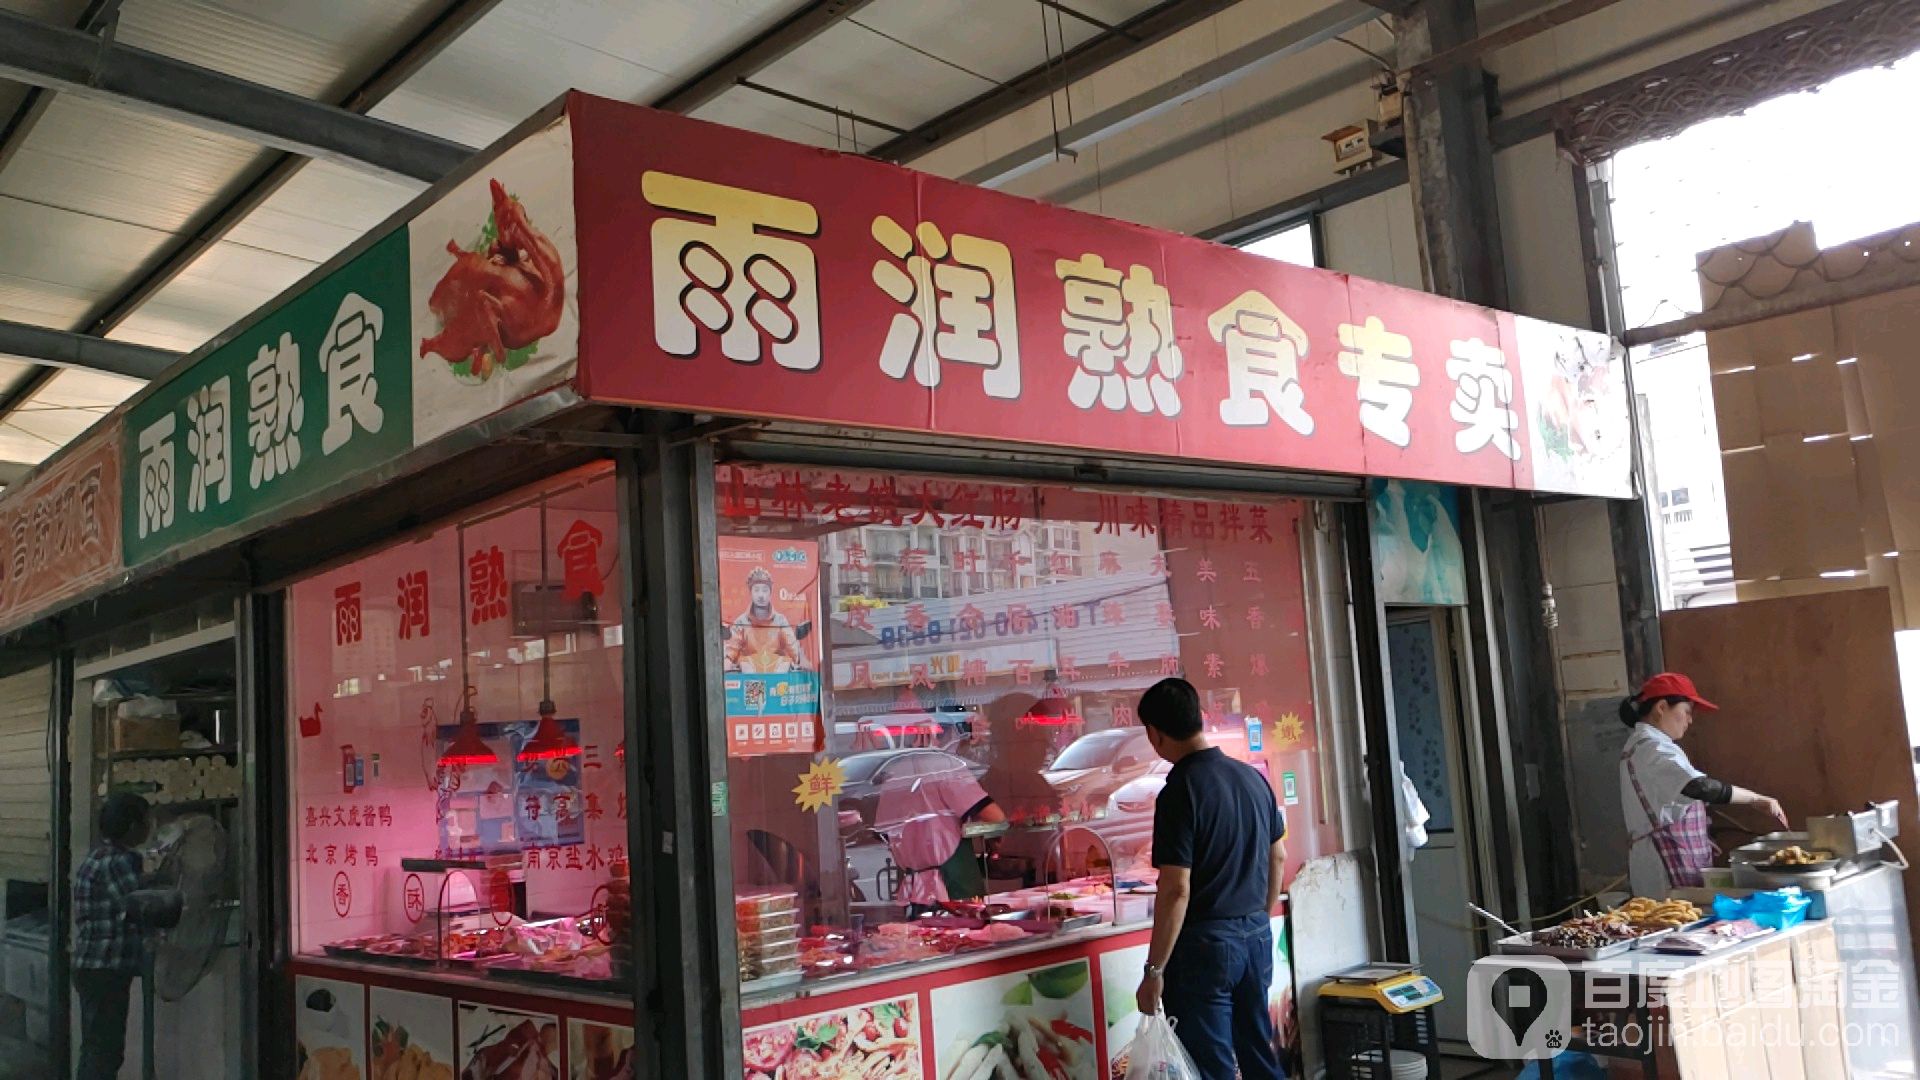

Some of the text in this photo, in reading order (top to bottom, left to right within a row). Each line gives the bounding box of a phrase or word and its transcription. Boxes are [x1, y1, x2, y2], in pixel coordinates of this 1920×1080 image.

[641, 170, 1522, 461] 雨润熟食专卖
[138, 292, 385, 540] 雨润熟食
[1094, 493, 1273, 544] 川味精品拌菜
[334, 519, 605, 646] 雨润熟食
[808, 772, 836, 796] 鲜
[305, 843, 379, 868] 北京烤鸭
[336, 883, 349, 905] 香
